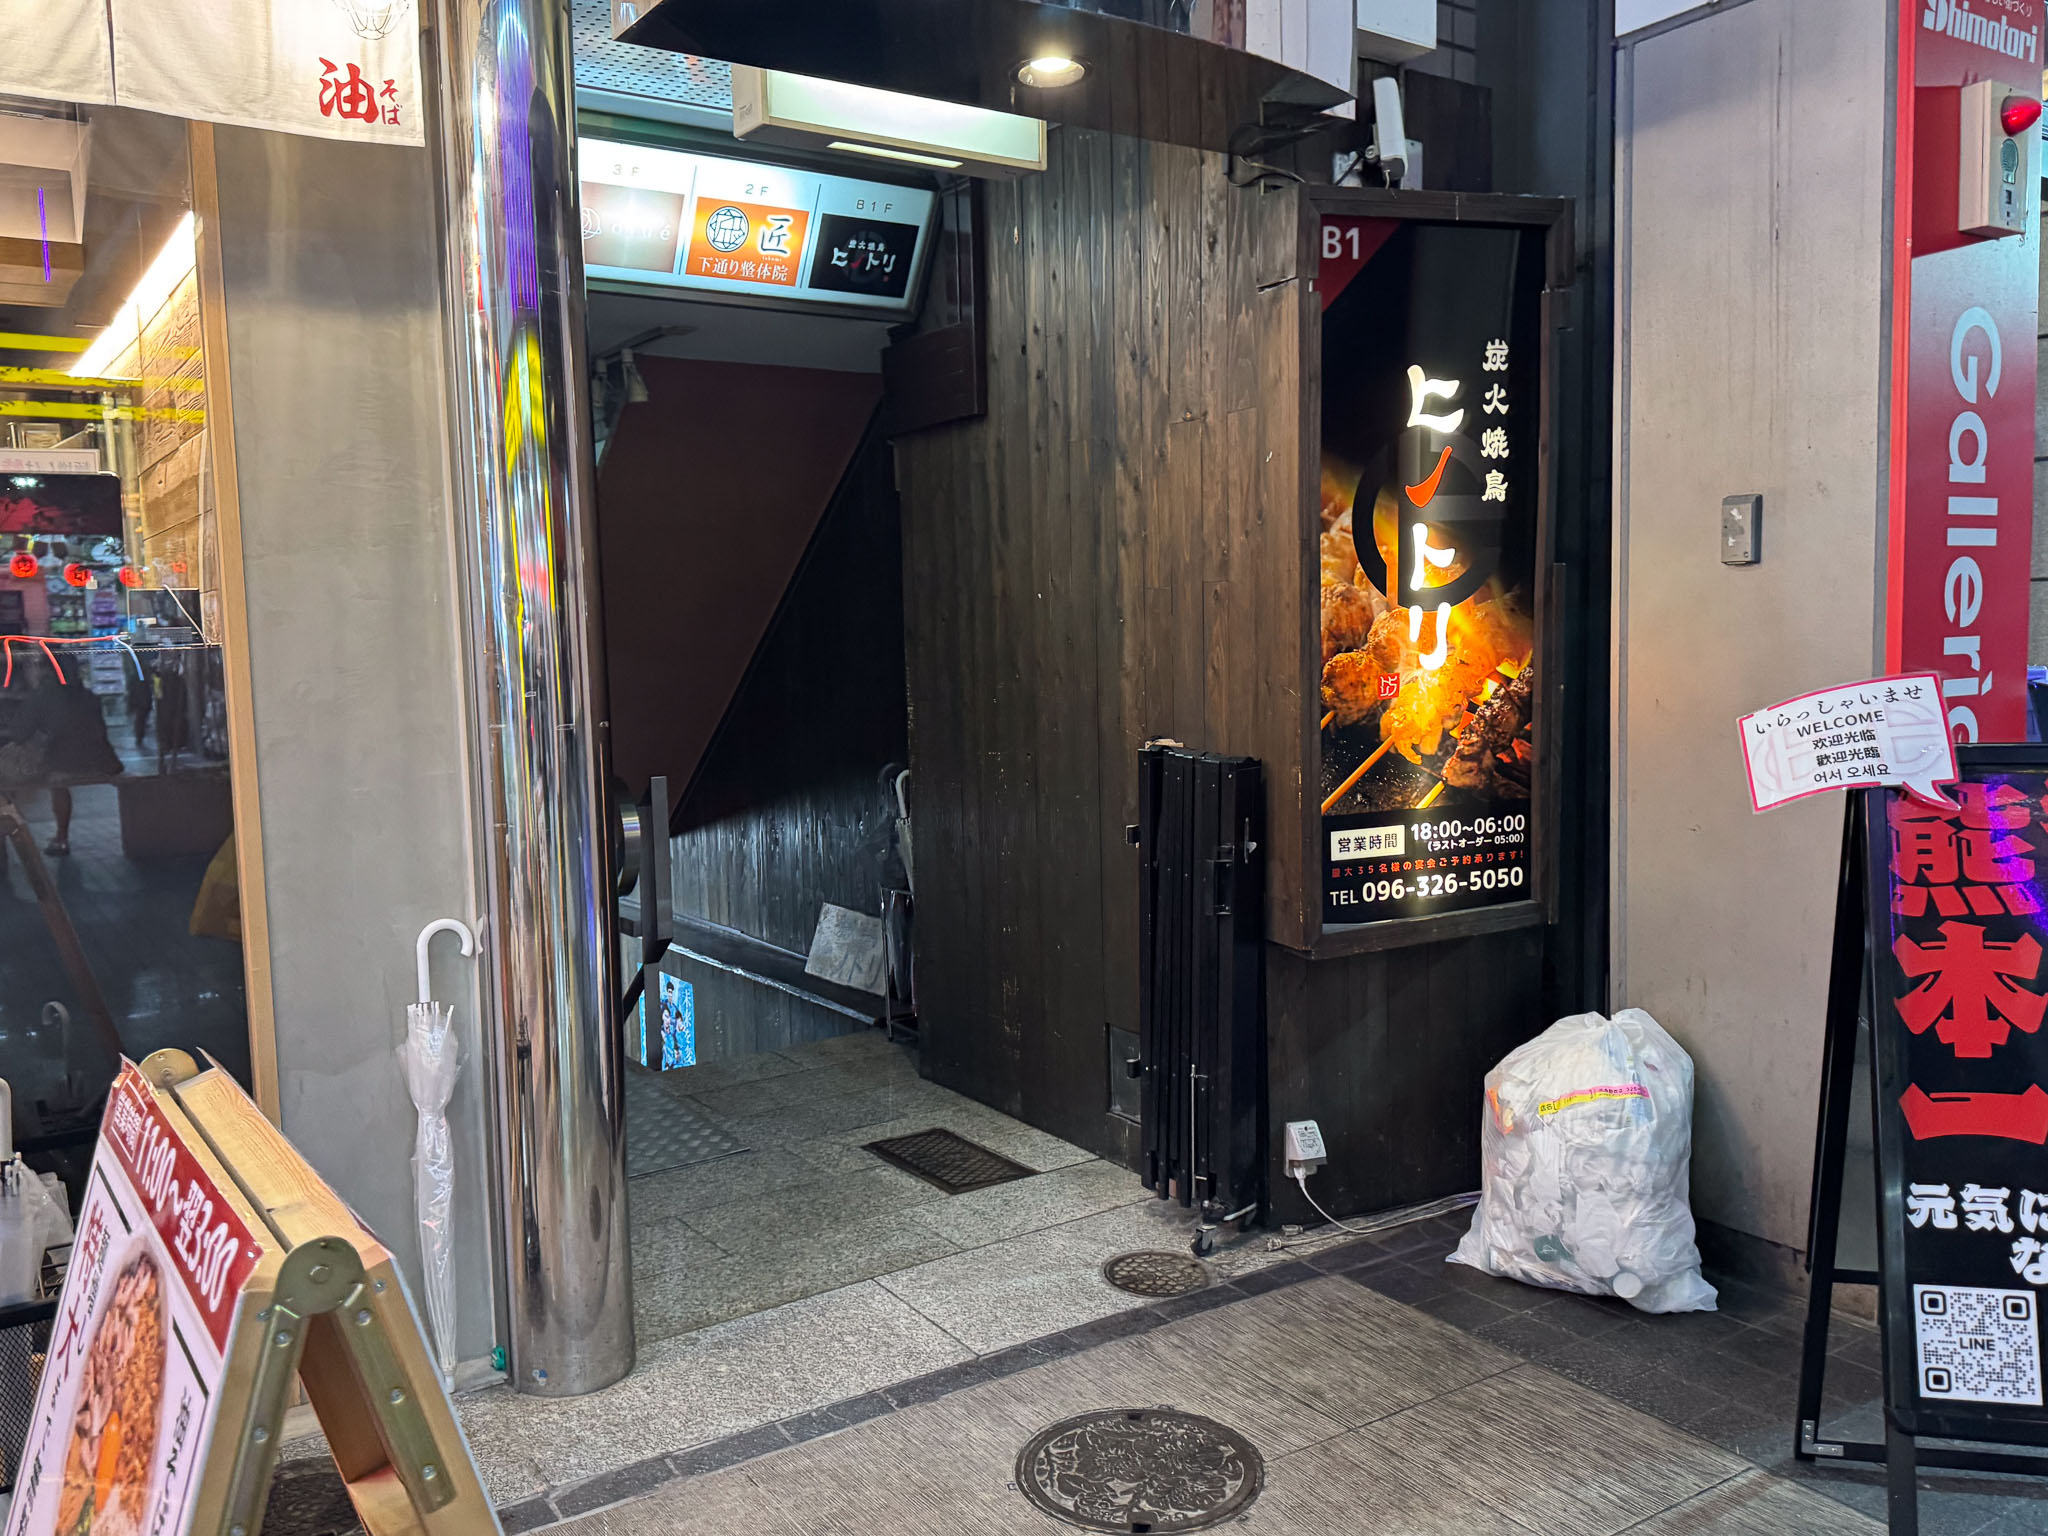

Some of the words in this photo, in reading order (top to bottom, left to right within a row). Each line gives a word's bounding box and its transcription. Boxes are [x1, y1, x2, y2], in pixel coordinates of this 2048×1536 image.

[1923, 0, 2037, 63] Shimotori
[760, 217, 791, 255] 匠
[1322, 225, 1359, 260] B1
[698, 256, 789, 281] 下通り整体院
[831, 247, 896, 273] ヒノトリ
[1405, 364, 1465, 671] ヒノトリ
[1755, 685, 1923, 735] いらっしゃいませ
[1796, 710, 1885, 737] WELCOME
[1812, 729, 1876, 750] 欢迎光临
[1816, 746, 1880, 767] 歡迎光臨
[1813, 768, 1842, 783] 어서
[1847, 763, 1891, 778] 오세요
[1337, 833, 1398, 853] 営業時間
[1329, 889, 1359, 906] TEL
[1362, 866, 1524, 903] 096-326-5050
[1959, 1336, 1997, 1351] LINE
